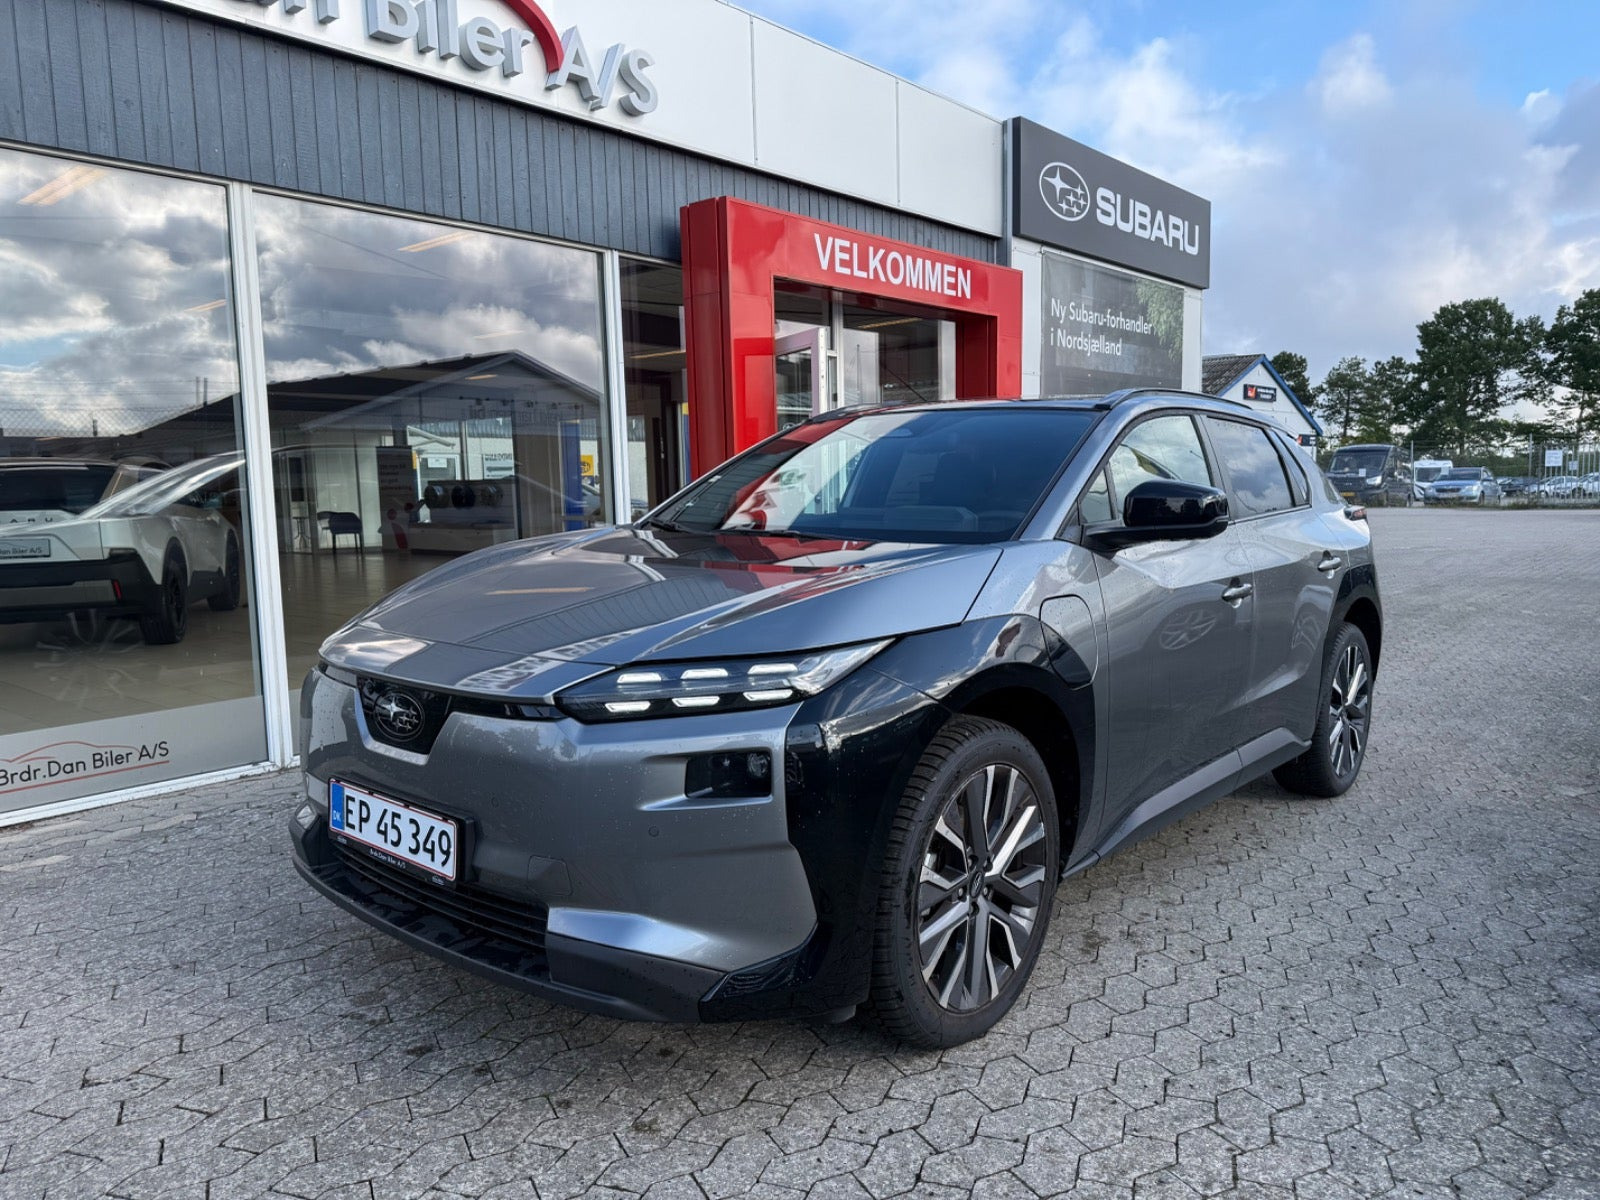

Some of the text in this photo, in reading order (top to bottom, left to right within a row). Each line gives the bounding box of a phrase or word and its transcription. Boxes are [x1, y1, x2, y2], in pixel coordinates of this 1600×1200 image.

[545, 25, 658, 116] A/S
[1096, 187, 1199, 256] SUBARU
[814, 233, 971, 299] VELKOMMEN
[1050, 327, 1122, 357] i Nordsjælland
[1051, 298, 1153, 335] Ny Subaru-forhandler
[92, 750, 133, 769] Biler
[138, 741, 169, 761] A/S
[345, 794, 452, 868] EP 45 349
